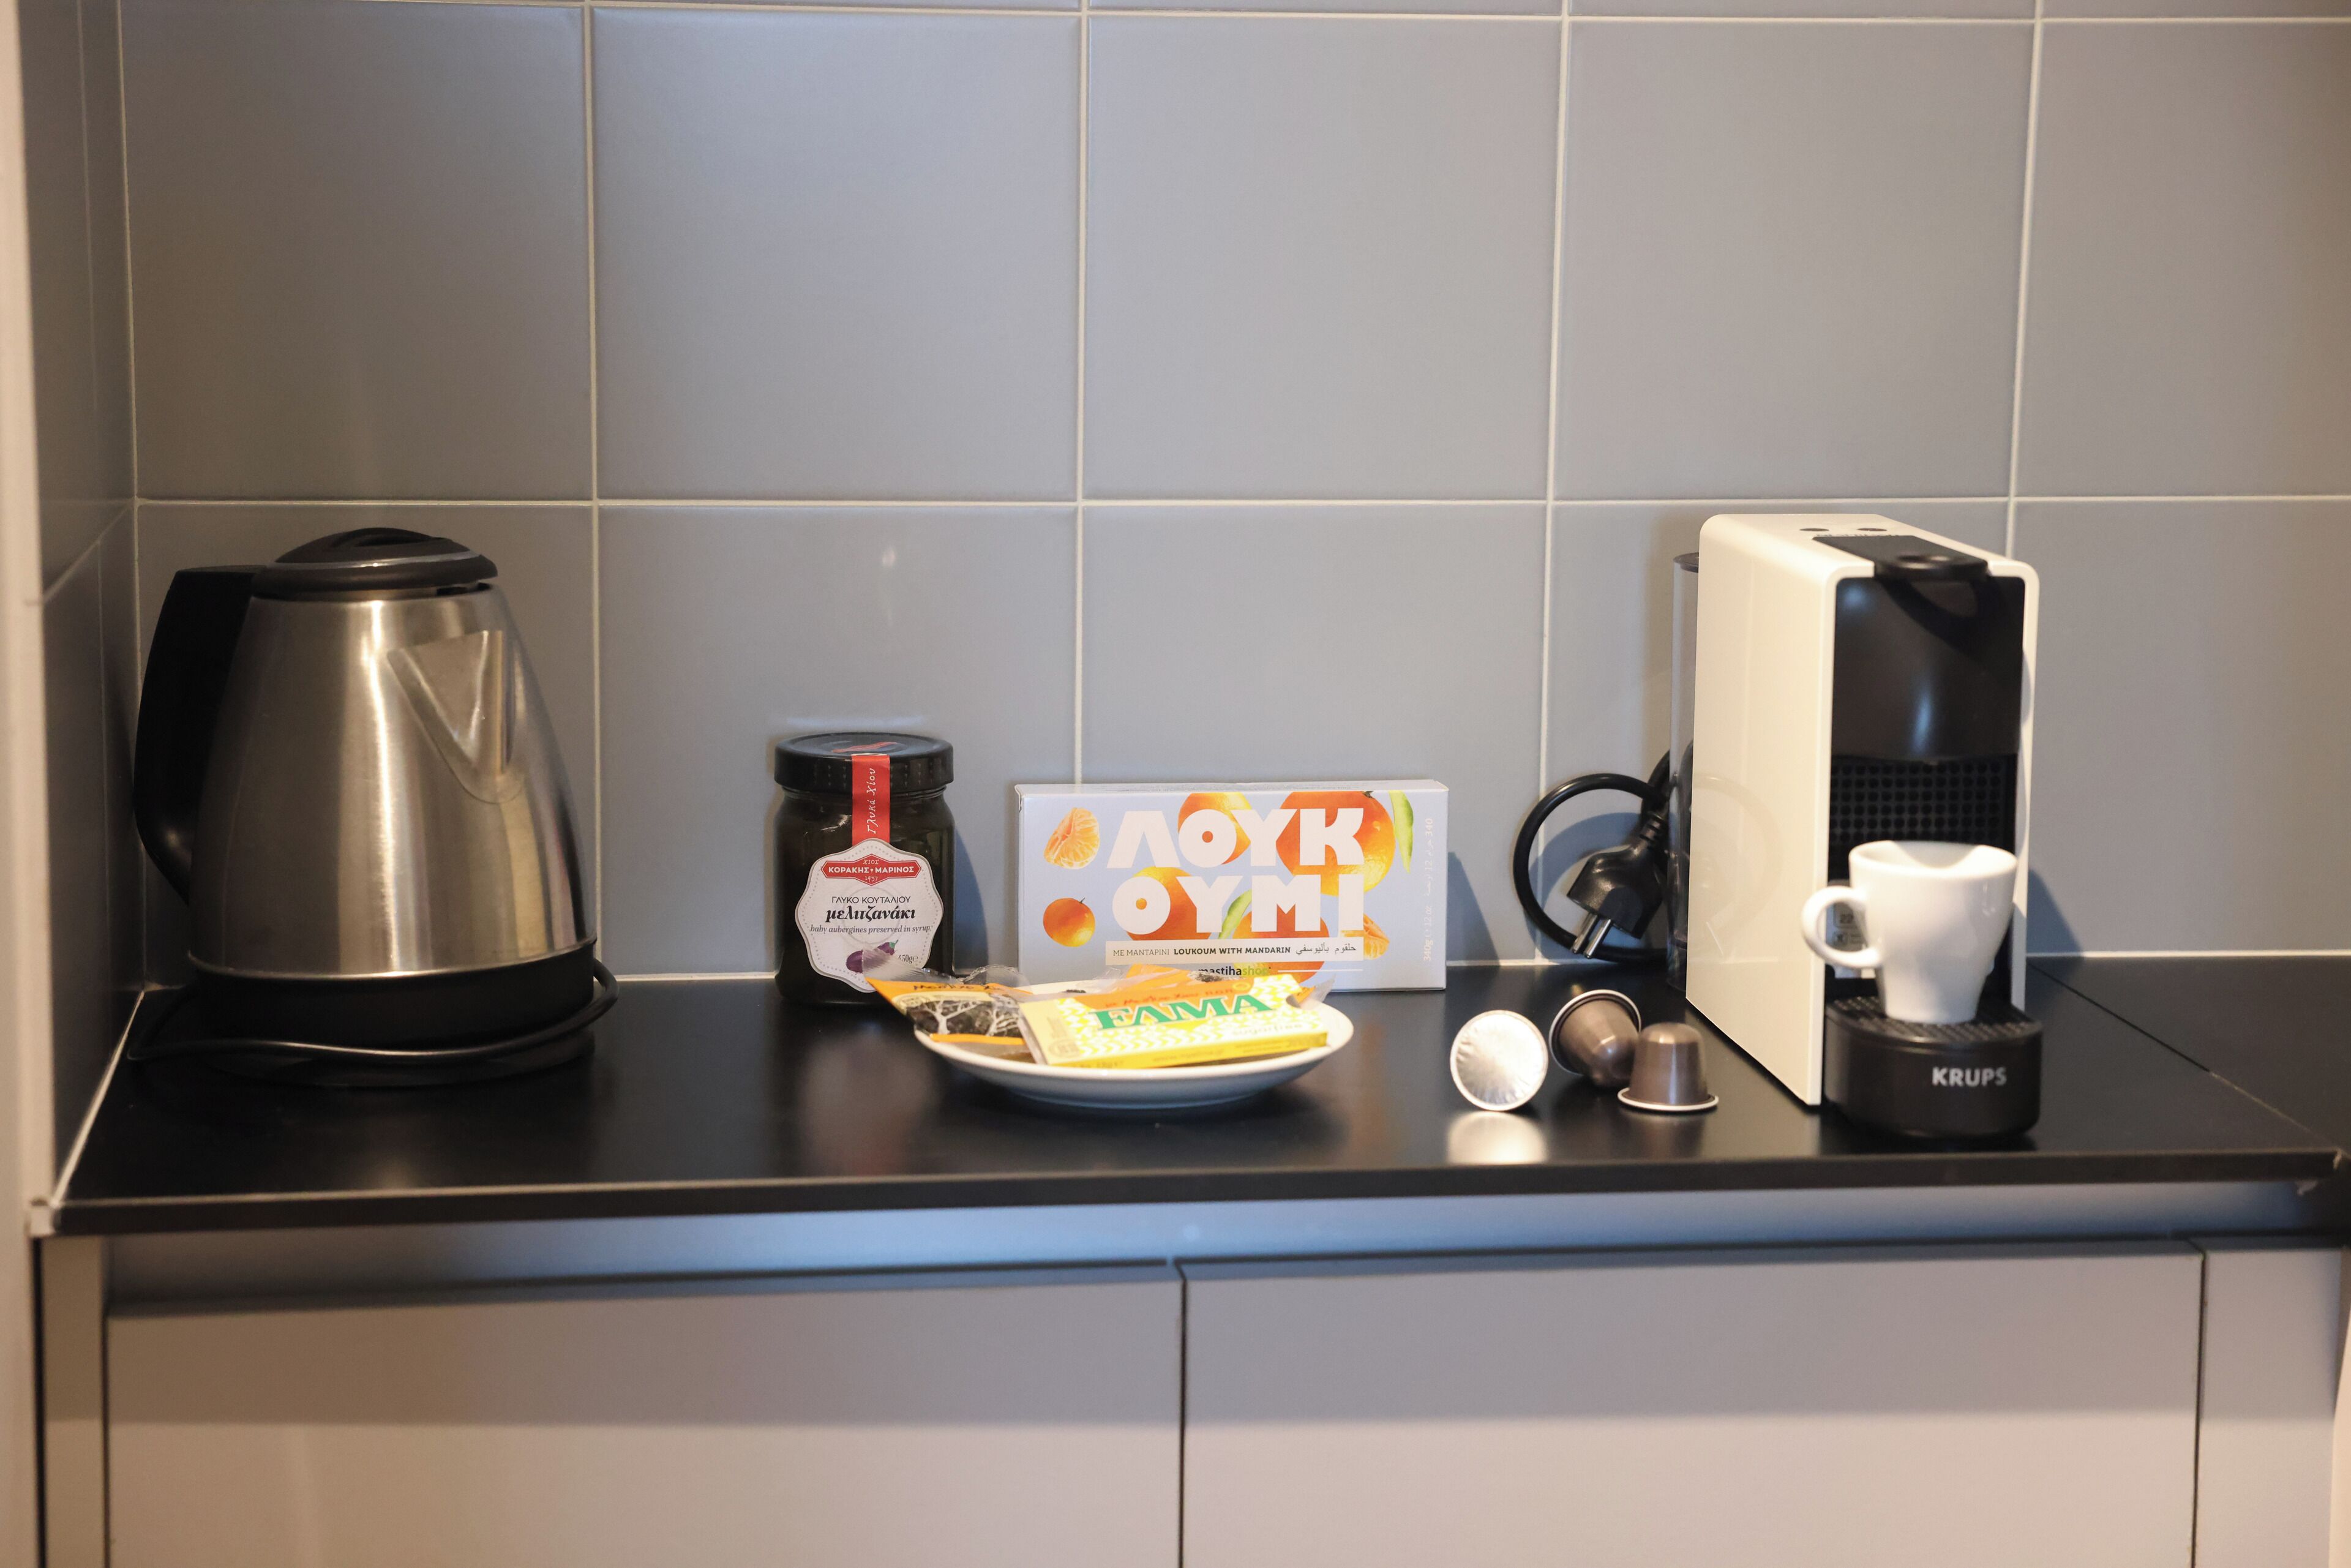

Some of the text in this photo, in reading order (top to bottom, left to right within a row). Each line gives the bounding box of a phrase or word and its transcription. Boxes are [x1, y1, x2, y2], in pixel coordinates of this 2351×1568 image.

[866, 767, 879, 835] Γλυκά Χίου
[1106, 808, 1365, 868] ΛΟΥΚ
[831, 896, 911, 904] ΓΛΥΚΟ ΚΟΥΤΑΛΙΟΥ
[1112, 874, 1365, 936] ΟΥΜΙ
[825, 905, 916, 923] μελιτζανάκι
[810, 924, 827, 934] baby
[828, 925, 867, 935] aubergines
[868, 924, 902, 935] preserved
[1932, 1066, 2008, 1087] KRUPS
